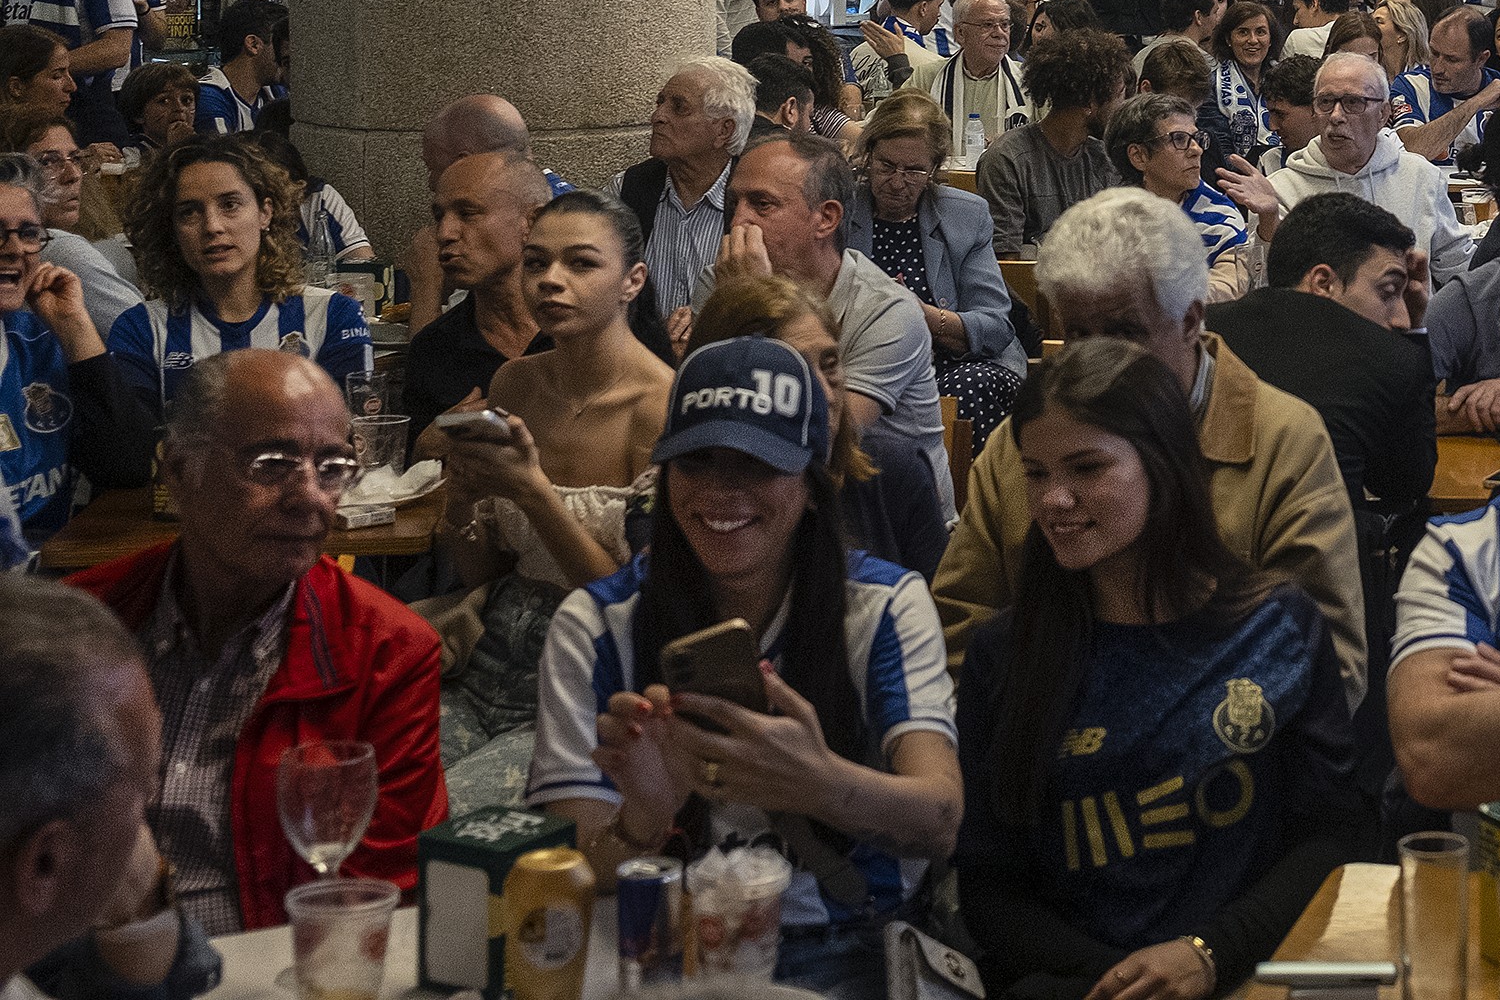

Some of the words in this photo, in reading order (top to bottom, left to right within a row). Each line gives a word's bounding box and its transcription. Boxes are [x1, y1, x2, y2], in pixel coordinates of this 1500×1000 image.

[169, 26, 196, 38] INAL
[681, 386, 773, 416] PORTO
[752, 368, 802, 419] 10
[1060, 759, 1255, 872] MEO
